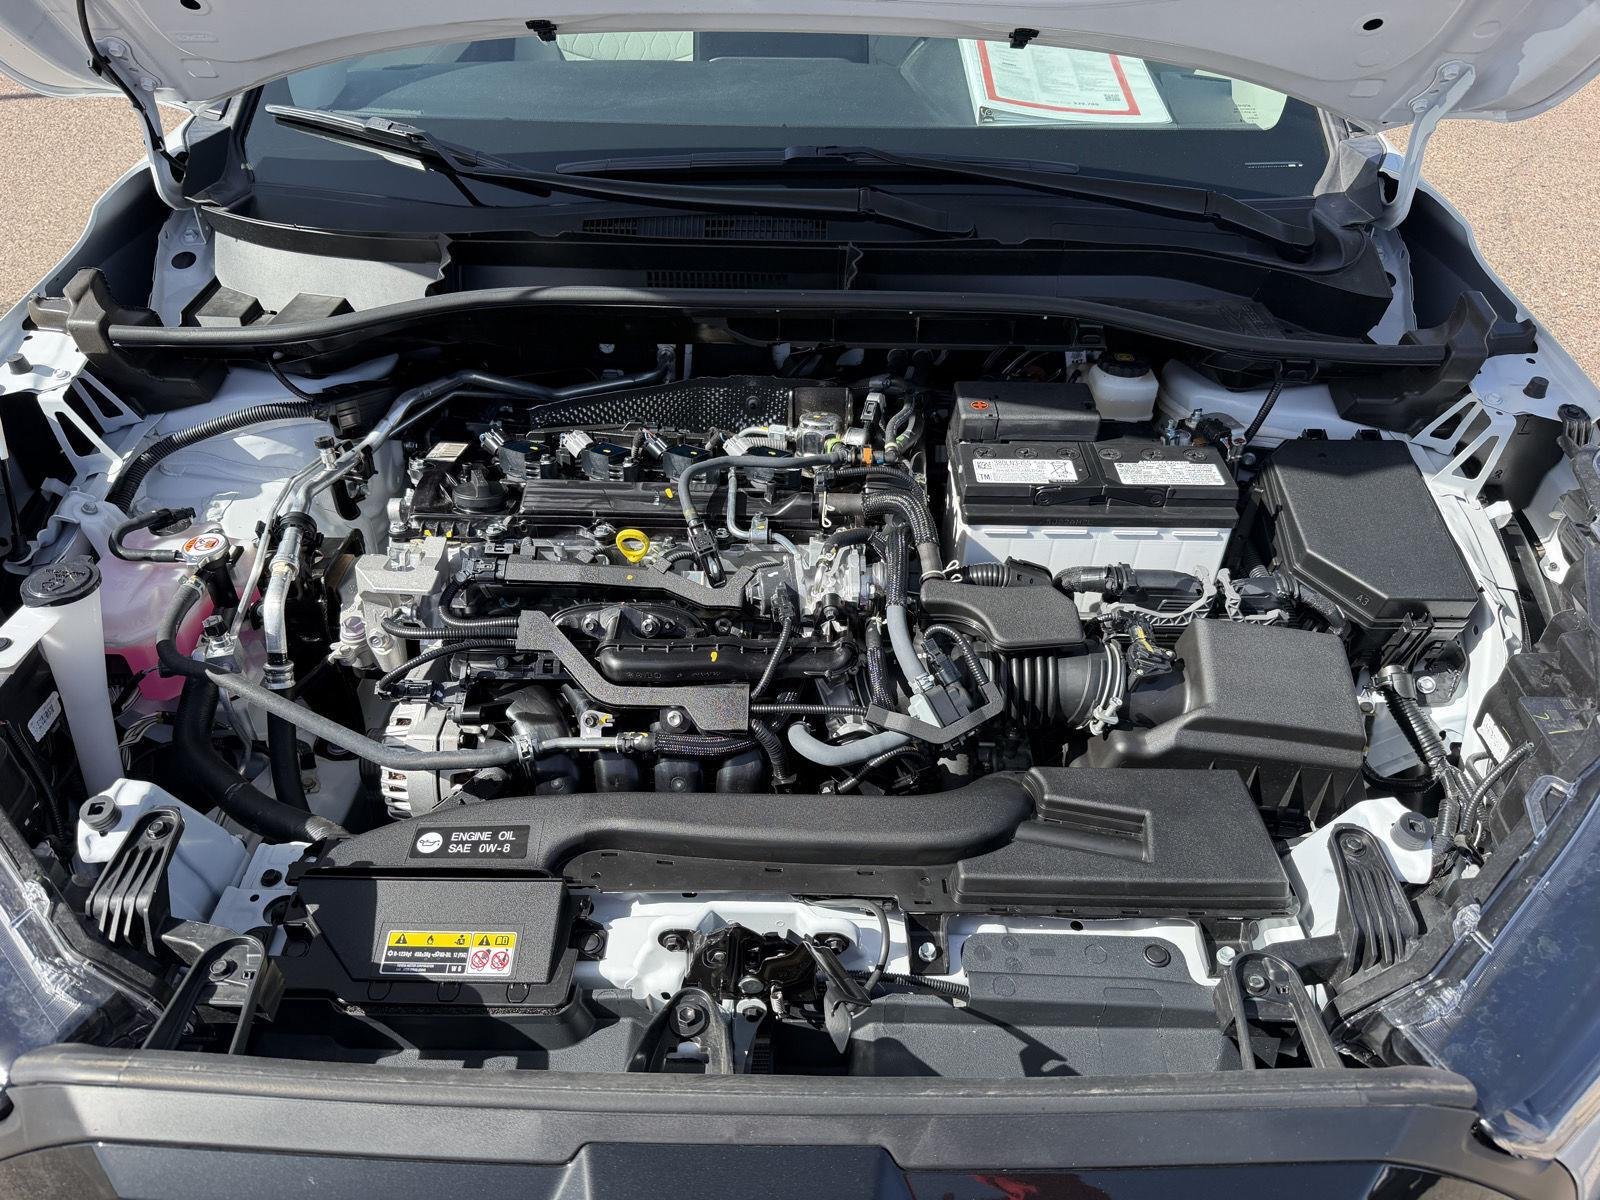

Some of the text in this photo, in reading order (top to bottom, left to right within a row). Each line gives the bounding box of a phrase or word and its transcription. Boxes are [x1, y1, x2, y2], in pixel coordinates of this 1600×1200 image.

[450, 830, 516, 842] ENGINE OIL
[448, 843, 511, 853] SAE 0W-8
